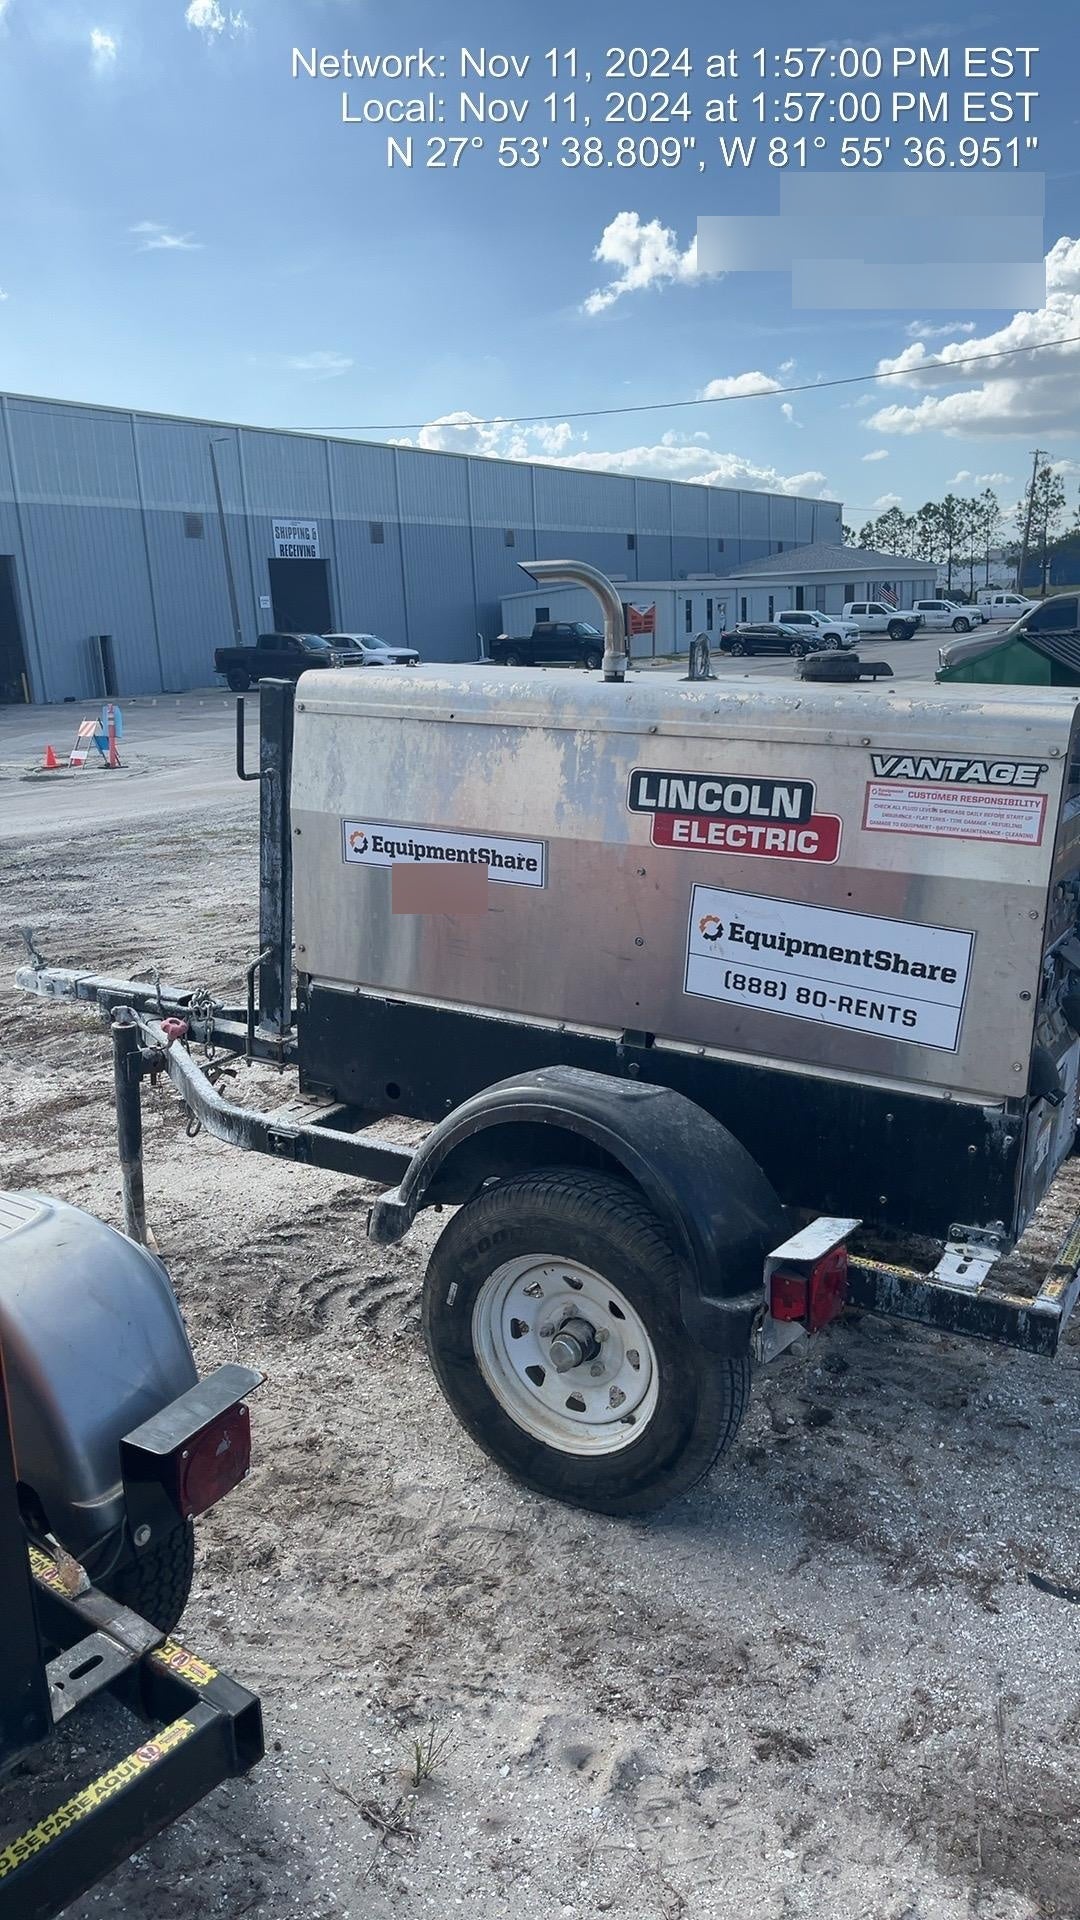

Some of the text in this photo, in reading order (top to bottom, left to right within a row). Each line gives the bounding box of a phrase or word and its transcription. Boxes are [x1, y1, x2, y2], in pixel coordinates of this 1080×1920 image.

[275, 526, 310, 540] SHIPPING
[279, 544, 316, 557] RECEIVING
[871, 754, 1040, 788] VANTAGE
[638, 777, 803, 819] LINCOLN
[908, 791, 1041, 808] CUSTOMER RESPONSIBILITY
[371, 835, 539, 872] EquipmentShare
[672, 820, 819, 854] ELECTRIC
[727, 922, 957, 984] EquipmentShare
[724, 970, 918, 1028] (888) 80-RENTS
[12, 1834, 41, 1857] SE
[43, 1796, 93, 1836] PARE
